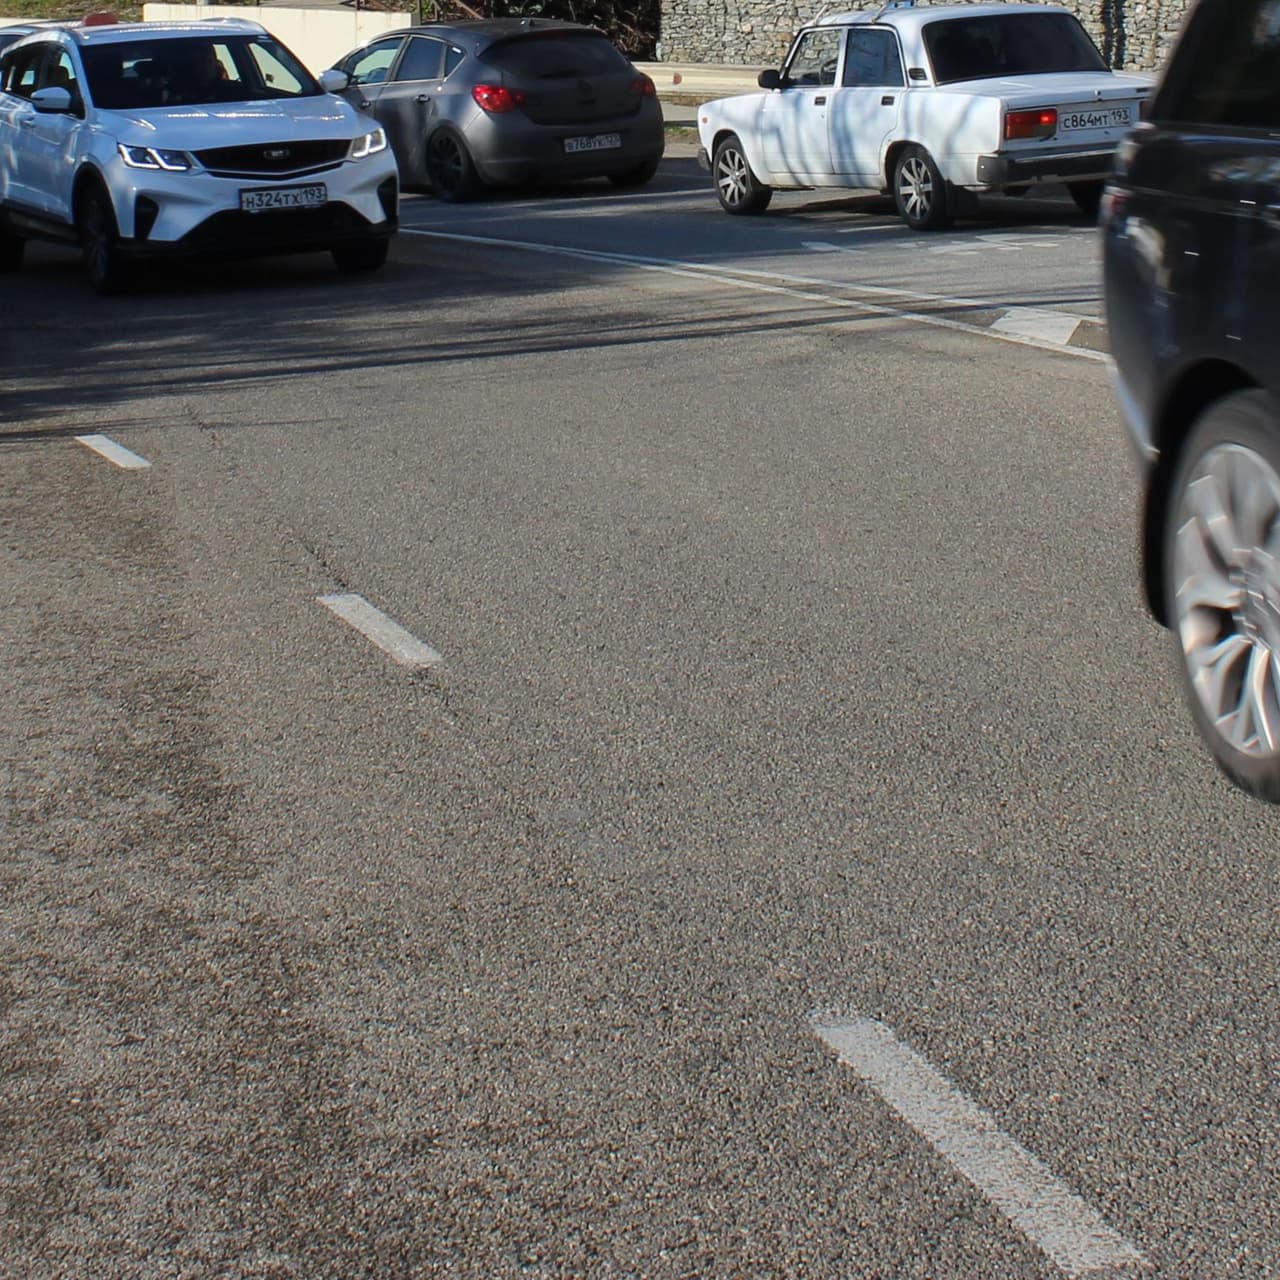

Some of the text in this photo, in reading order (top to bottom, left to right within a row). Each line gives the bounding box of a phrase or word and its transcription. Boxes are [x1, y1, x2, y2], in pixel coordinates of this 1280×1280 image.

[1111, 110, 1129, 121] 193
[246, 187, 322, 208] Н324ТХ 193
